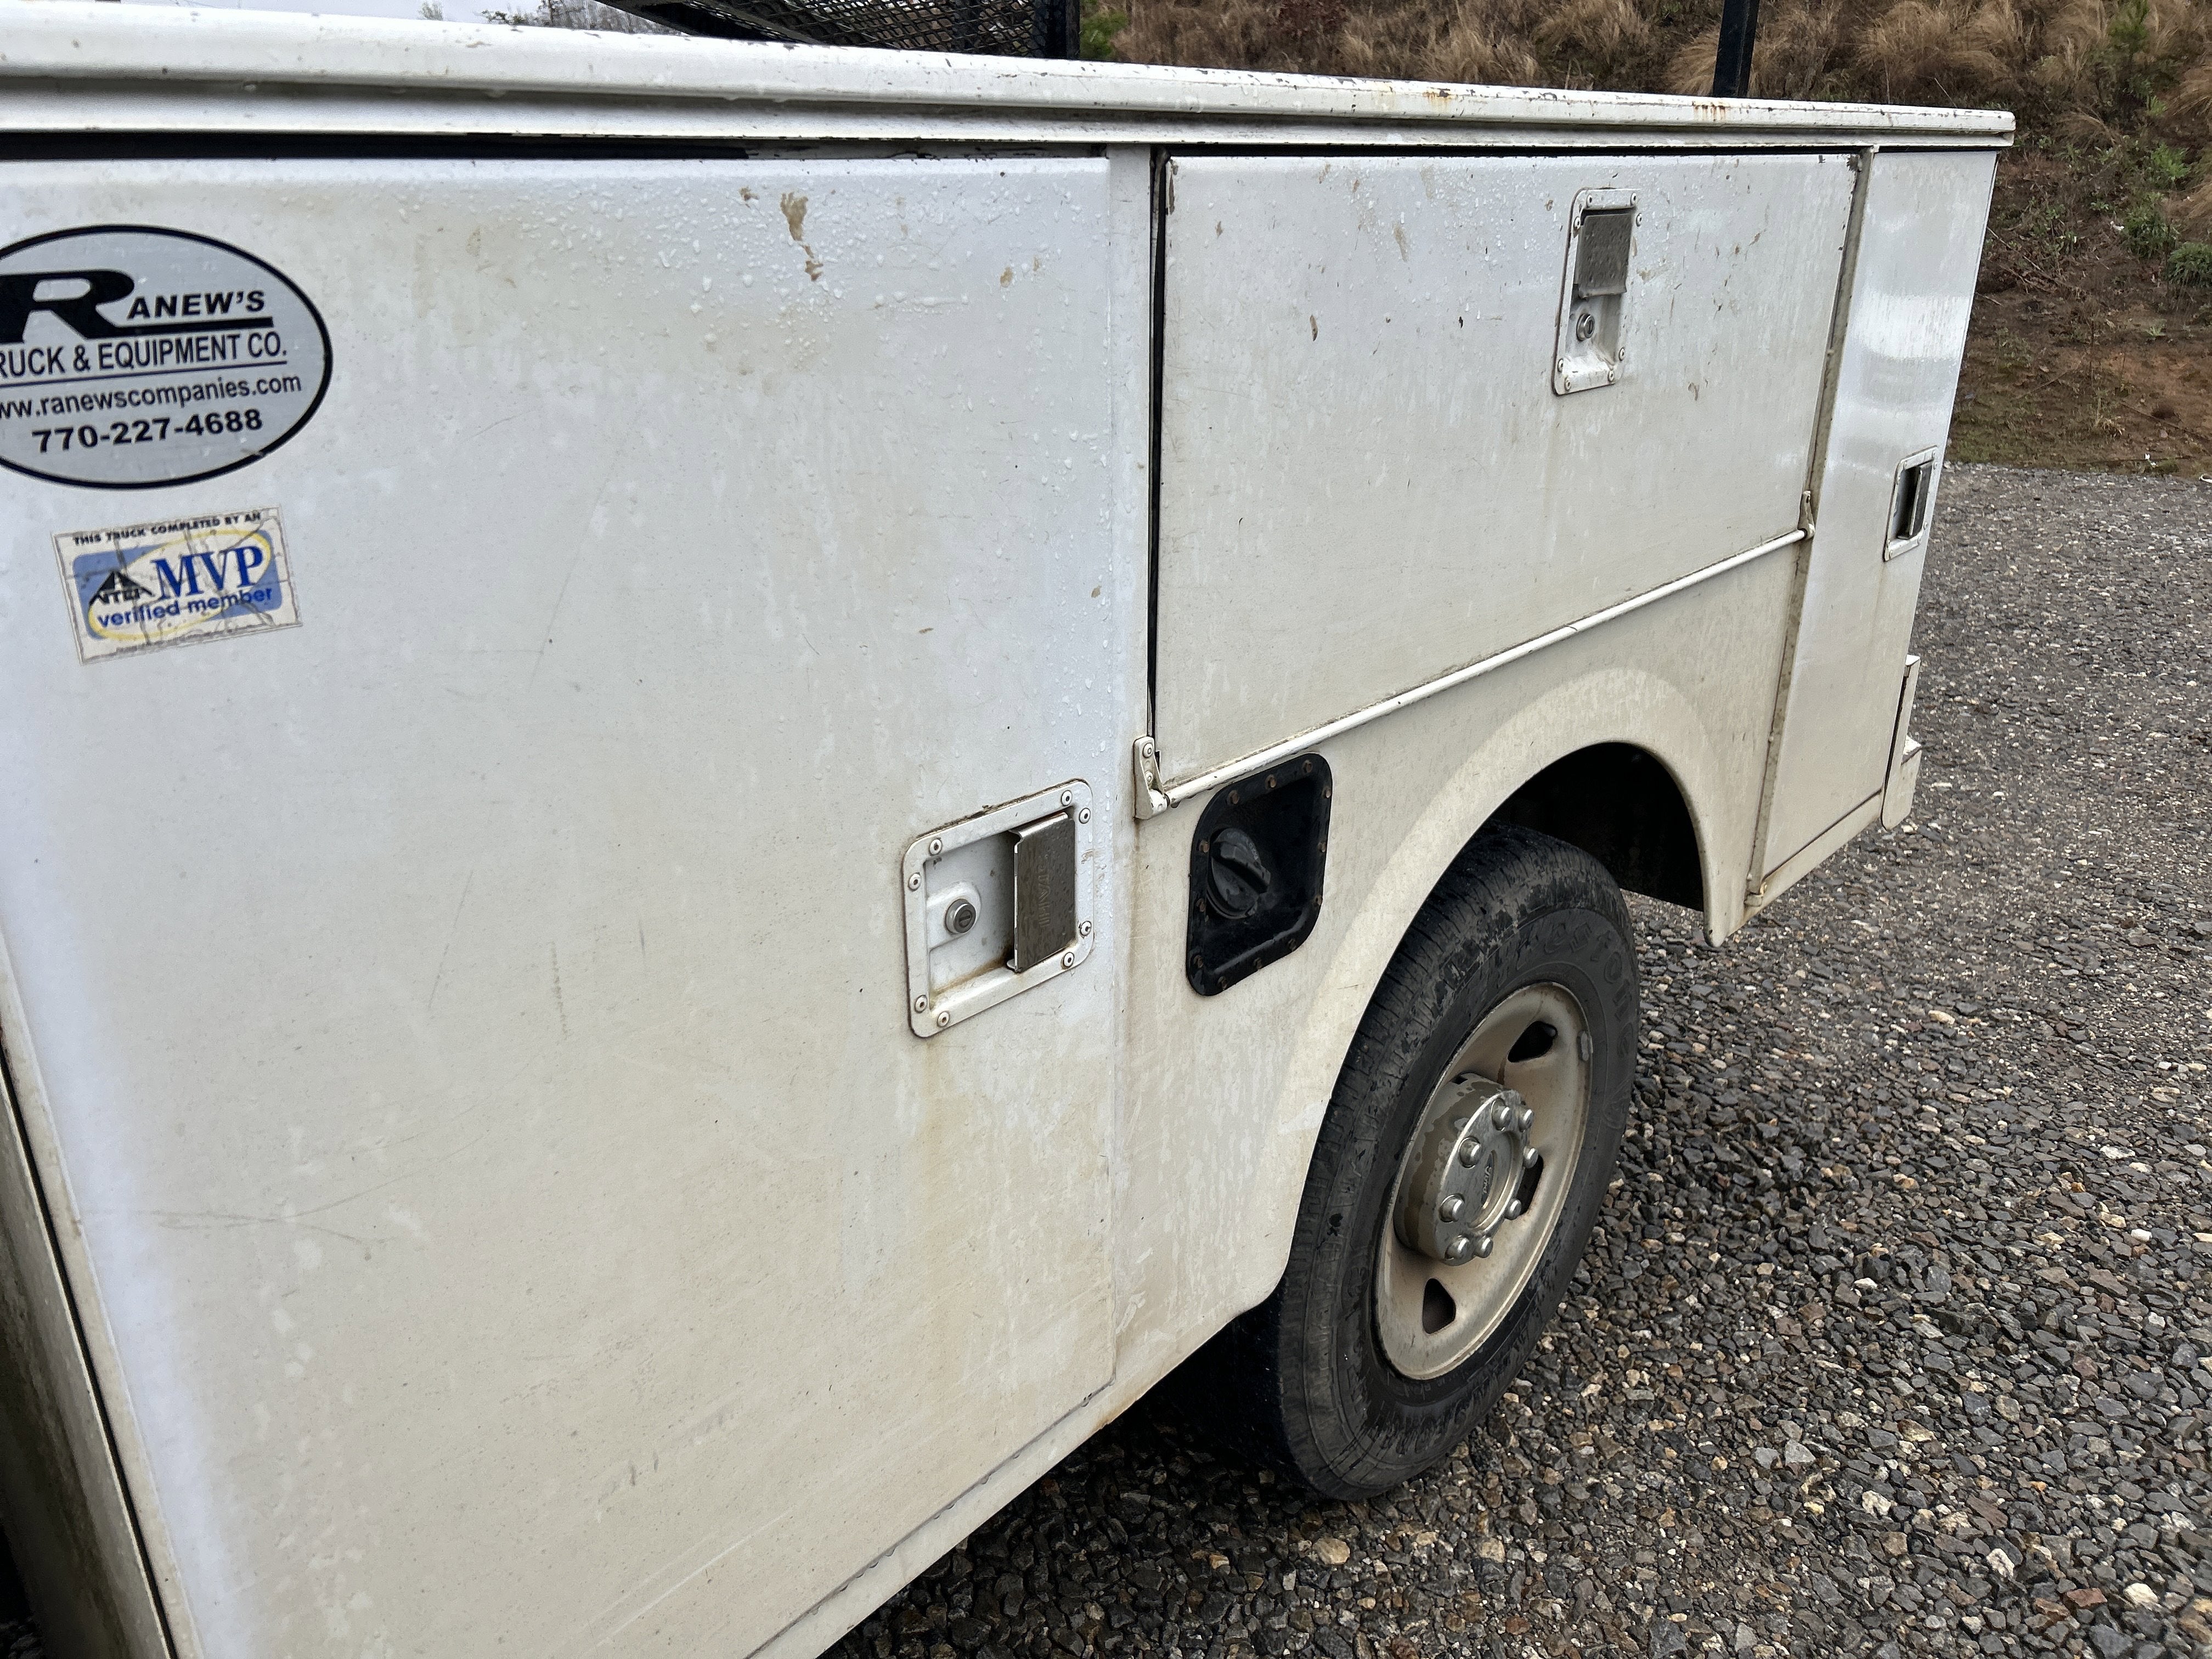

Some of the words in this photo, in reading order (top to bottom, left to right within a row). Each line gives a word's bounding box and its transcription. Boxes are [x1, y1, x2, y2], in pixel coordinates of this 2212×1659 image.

[72, 346, 90, 371] &
[99, 336, 239, 370] EQUIPMENT
[247, 331, 287, 357] CO.
[32, 409, 263, 453] 770-227-4688
[73, 534, 101, 545] THIS
[108, 528, 145, 540] TRUCK
[151, 522, 219, 534] COMPLETED
[225, 516, 239, 525] BY
[245, 512, 262, 521] AN
[152, 546, 263, 600] MVP
[97, 601, 180, 627] verified
[188, 588, 272, 613] member
